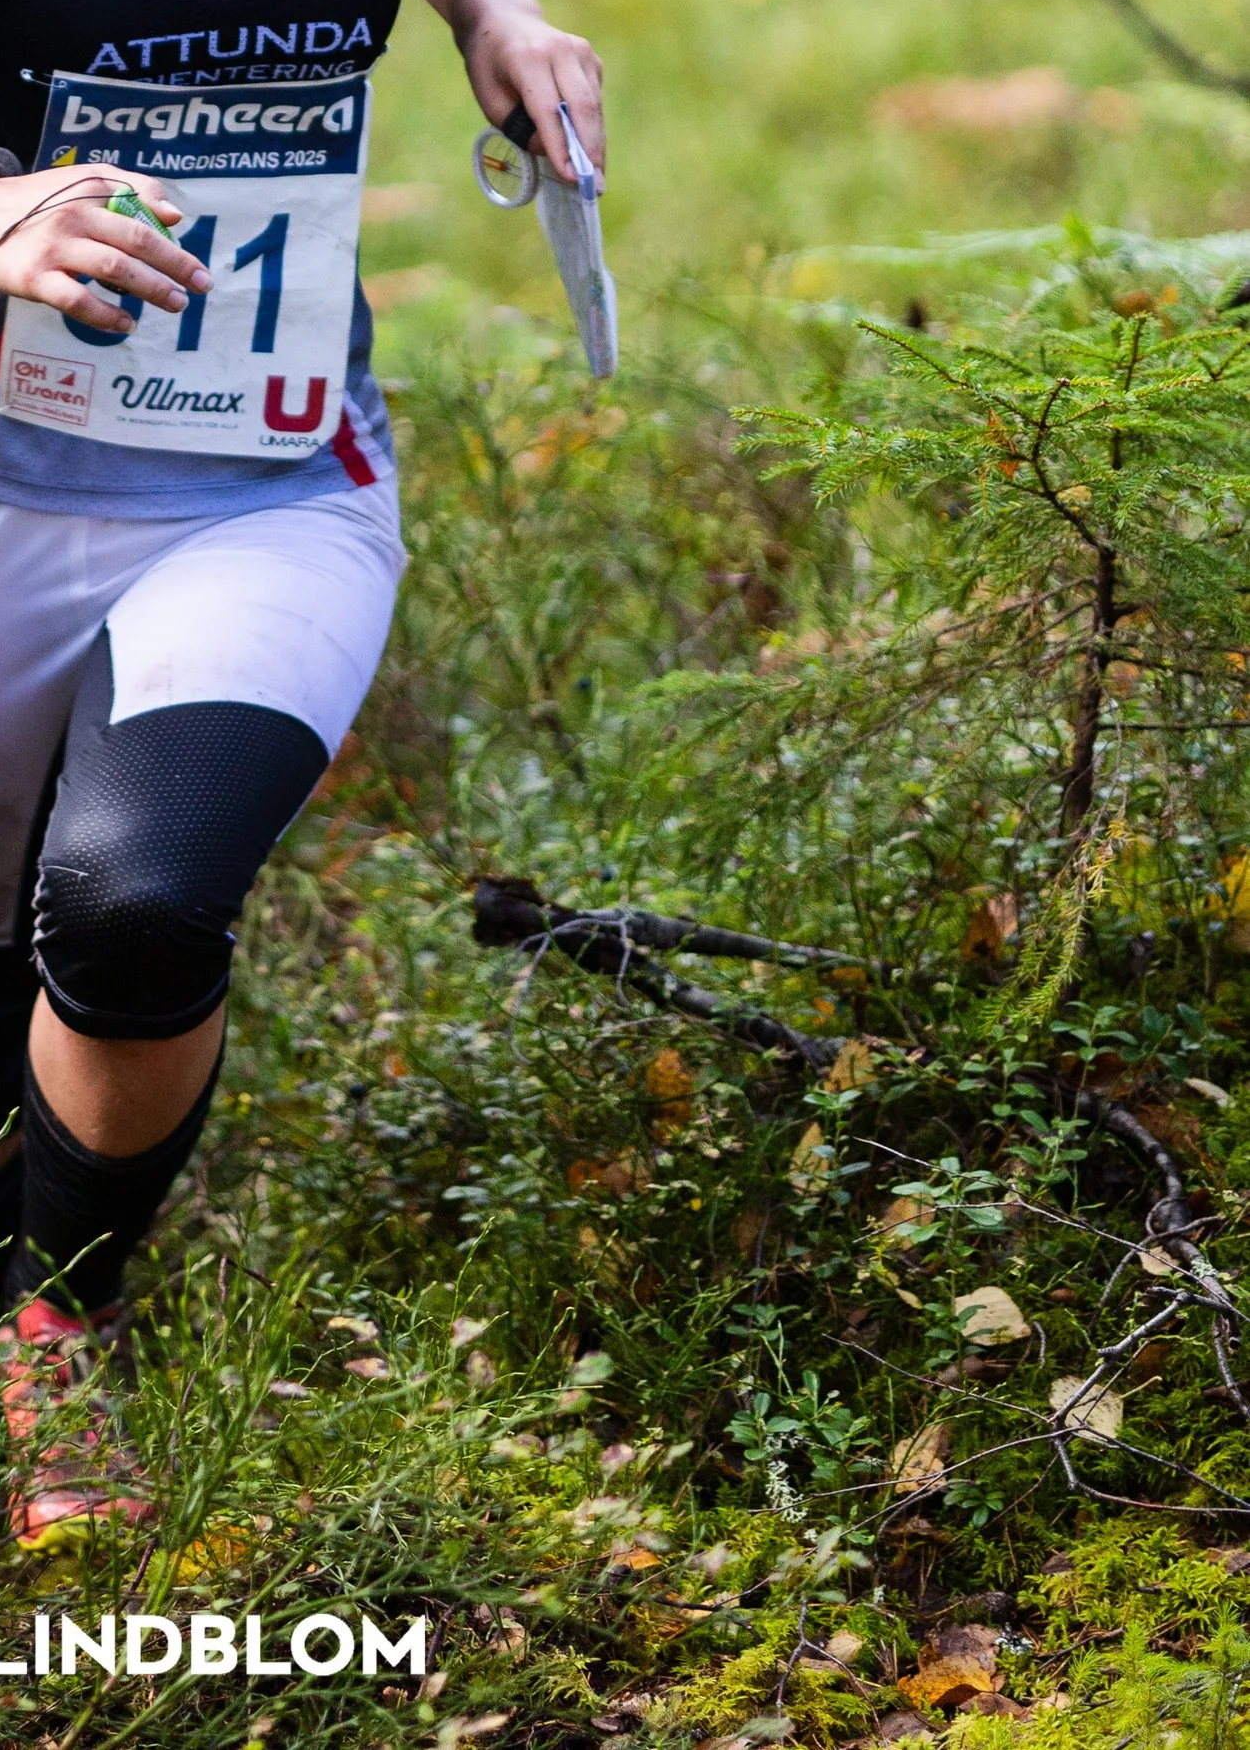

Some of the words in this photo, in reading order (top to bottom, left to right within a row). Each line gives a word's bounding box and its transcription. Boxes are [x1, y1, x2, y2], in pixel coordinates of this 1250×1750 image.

[86, 17, 372, 74] ATTUNDA
[135, 60, 355, 86] IENTERING
[60, 95, 355, 140] bagheera
[87, 148, 120, 165] SM
[283, 149, 327, 168] 2025
[111, 375, 244, 414] Ullmax
[259, 434, 321, 449] UMARA
